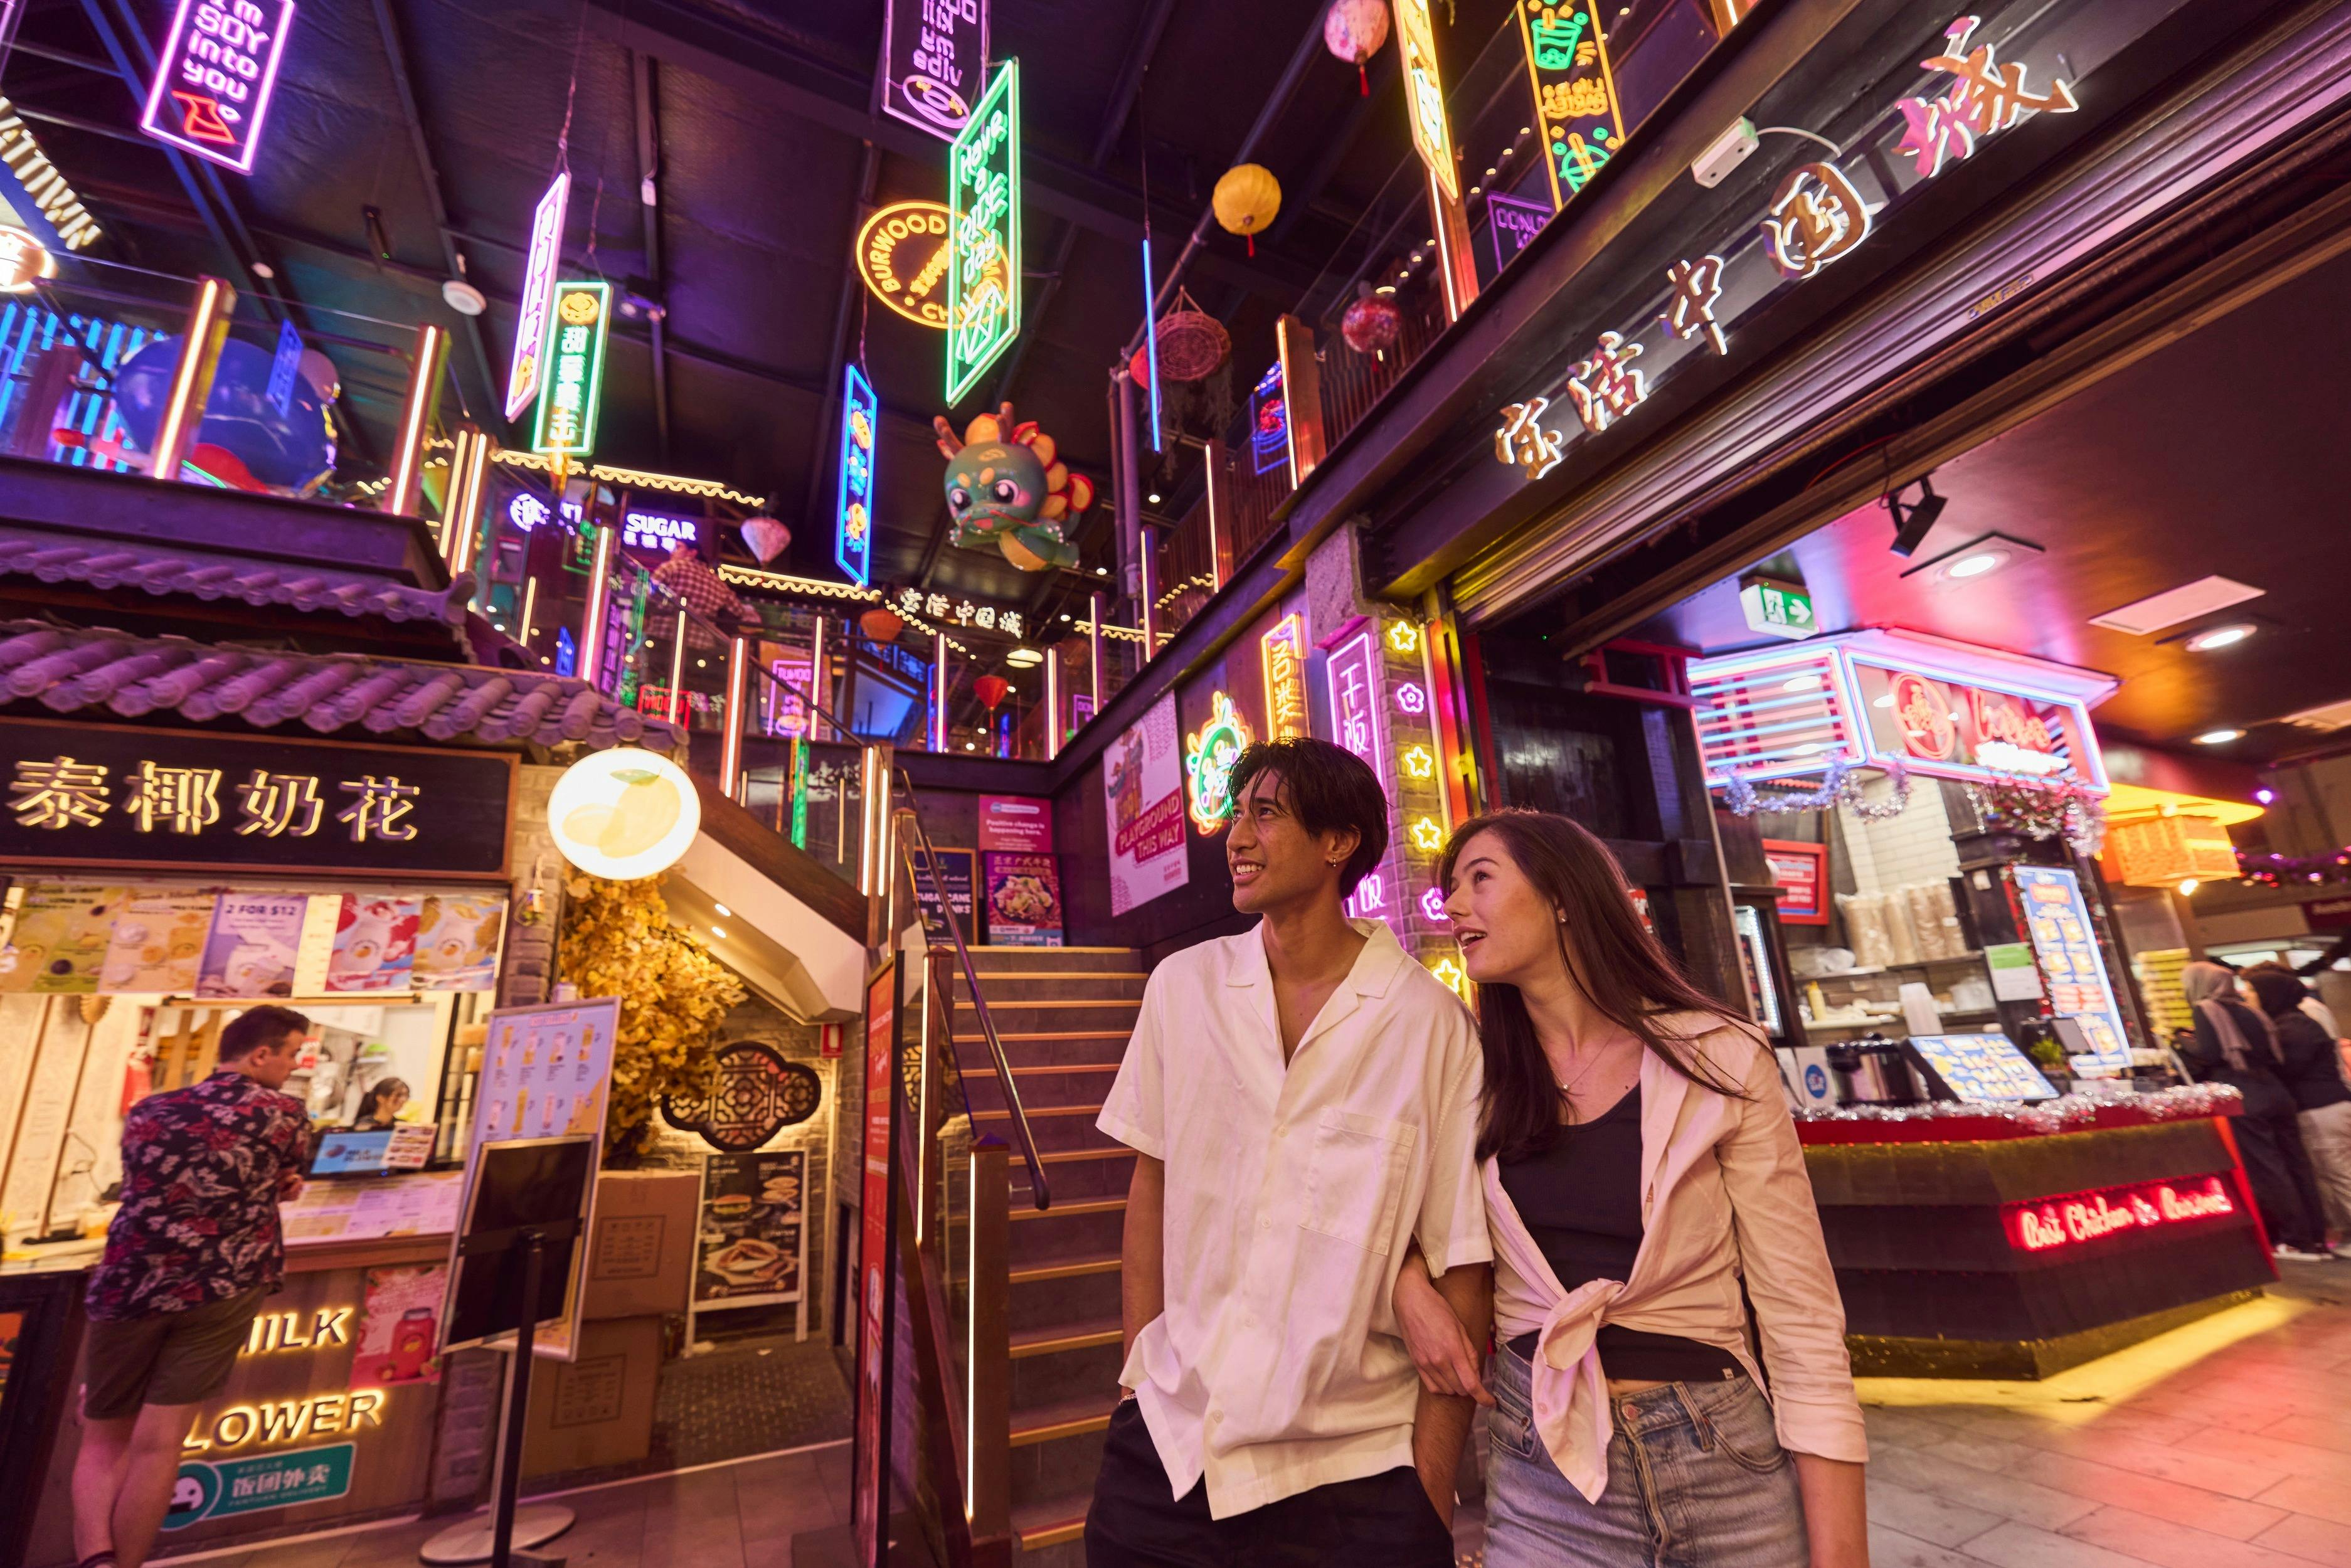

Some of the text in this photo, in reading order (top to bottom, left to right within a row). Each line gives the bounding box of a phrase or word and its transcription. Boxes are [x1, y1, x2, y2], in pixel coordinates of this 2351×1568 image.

[188, 29, 260, 81] into
[194, 3, 270, 55] SOY
[183, 58, 249, 103] you
[960, 109, 1006, 185] Have
[975, 166, 989, 194] a
[959, 172, 1007, 256] RICE
[871, 214, 947, 294] BURWOOD
[963, 228, 1002, 285] day
[625, 512, 696, 541] SUGAR
[8, 755, 421, 842] 泰椰奶花
[1118, 795, 1179, 851] PLAYGROUND
[1136, 835, 1159, 859] THIS
[1158, 822, 1179, 849] WAY
[226, 904, 235, 914] 2
[238, 904, 267, 914] FOR
[270, 905, 297, 916] $12
[232, 1464, 332, 1498] 饭团外卖
